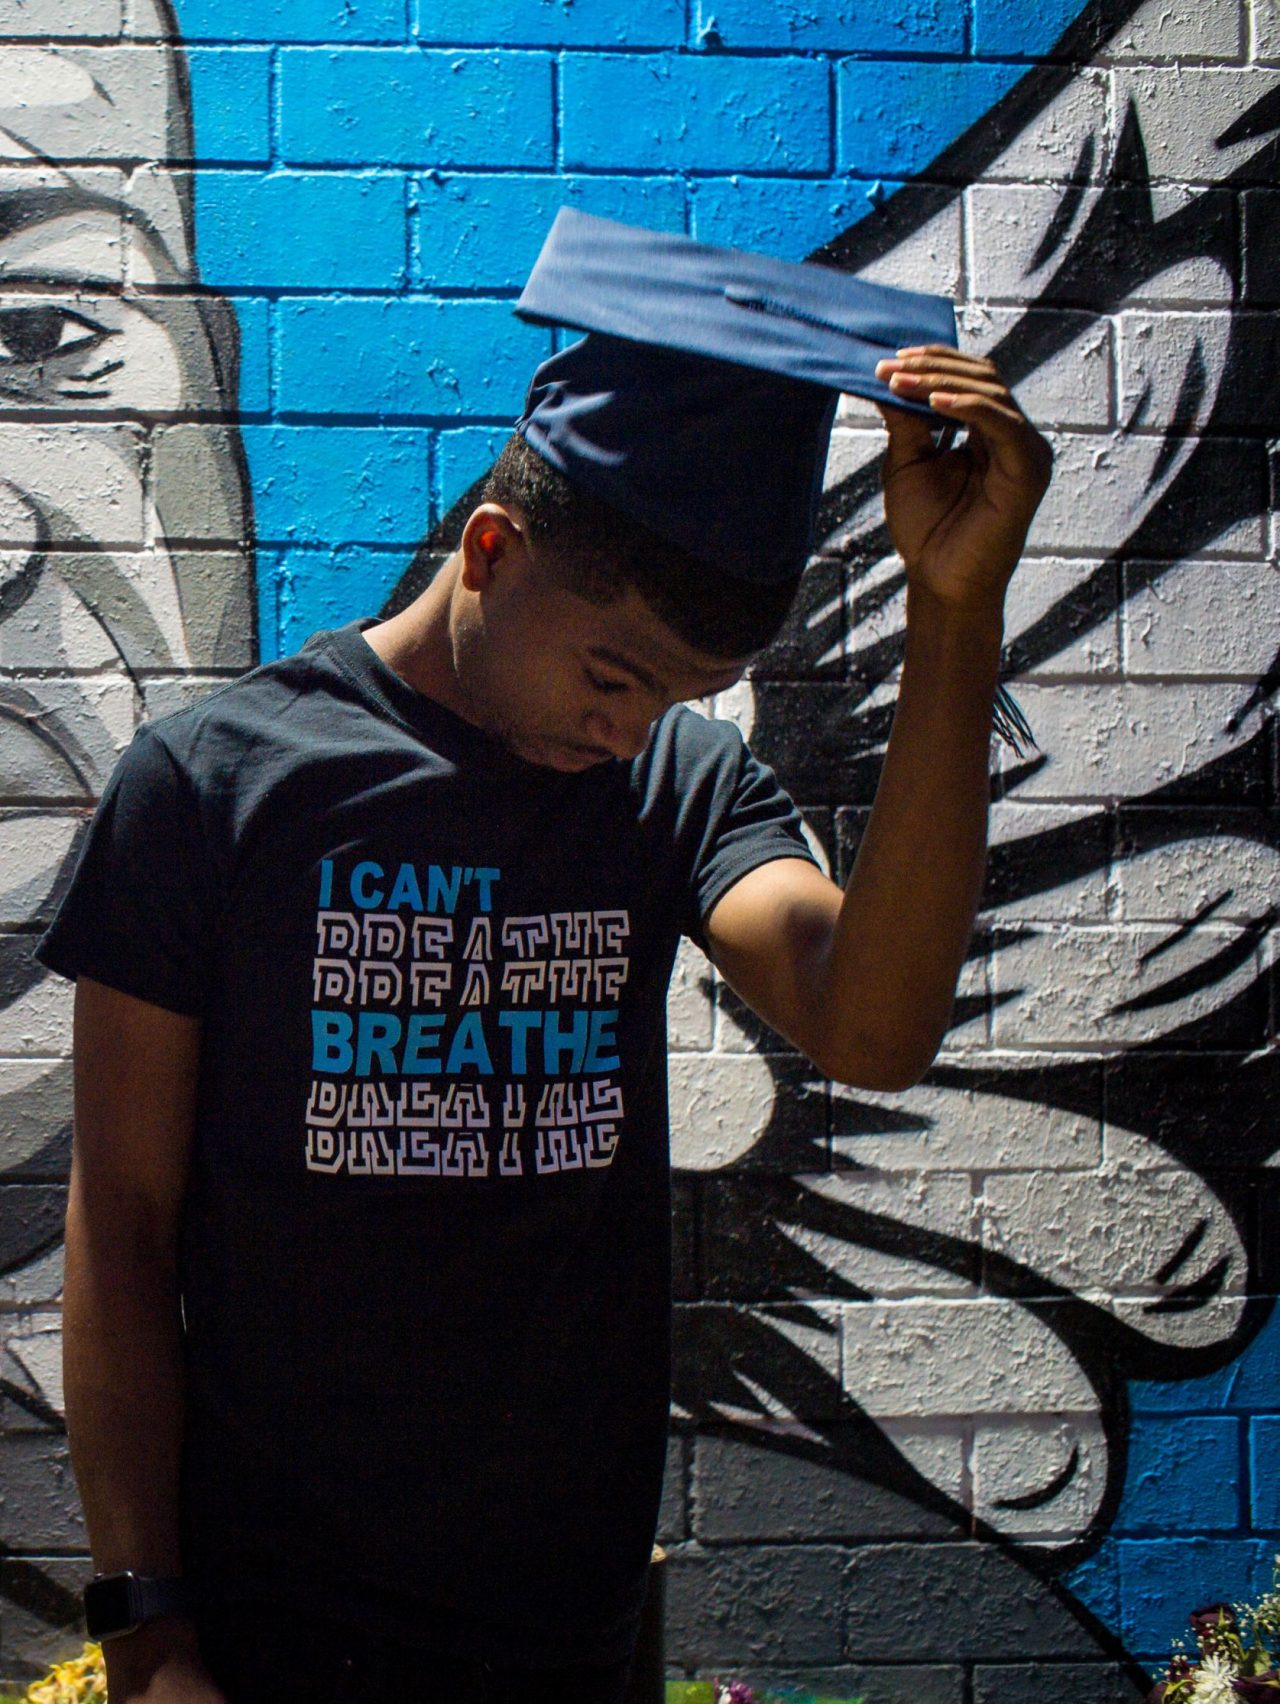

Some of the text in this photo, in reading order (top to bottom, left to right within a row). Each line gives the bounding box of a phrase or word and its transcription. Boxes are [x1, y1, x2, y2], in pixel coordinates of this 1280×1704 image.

[319, 860, 500, 913] I CAN'T
[311, 1010, 620, 1076] BREATHE
